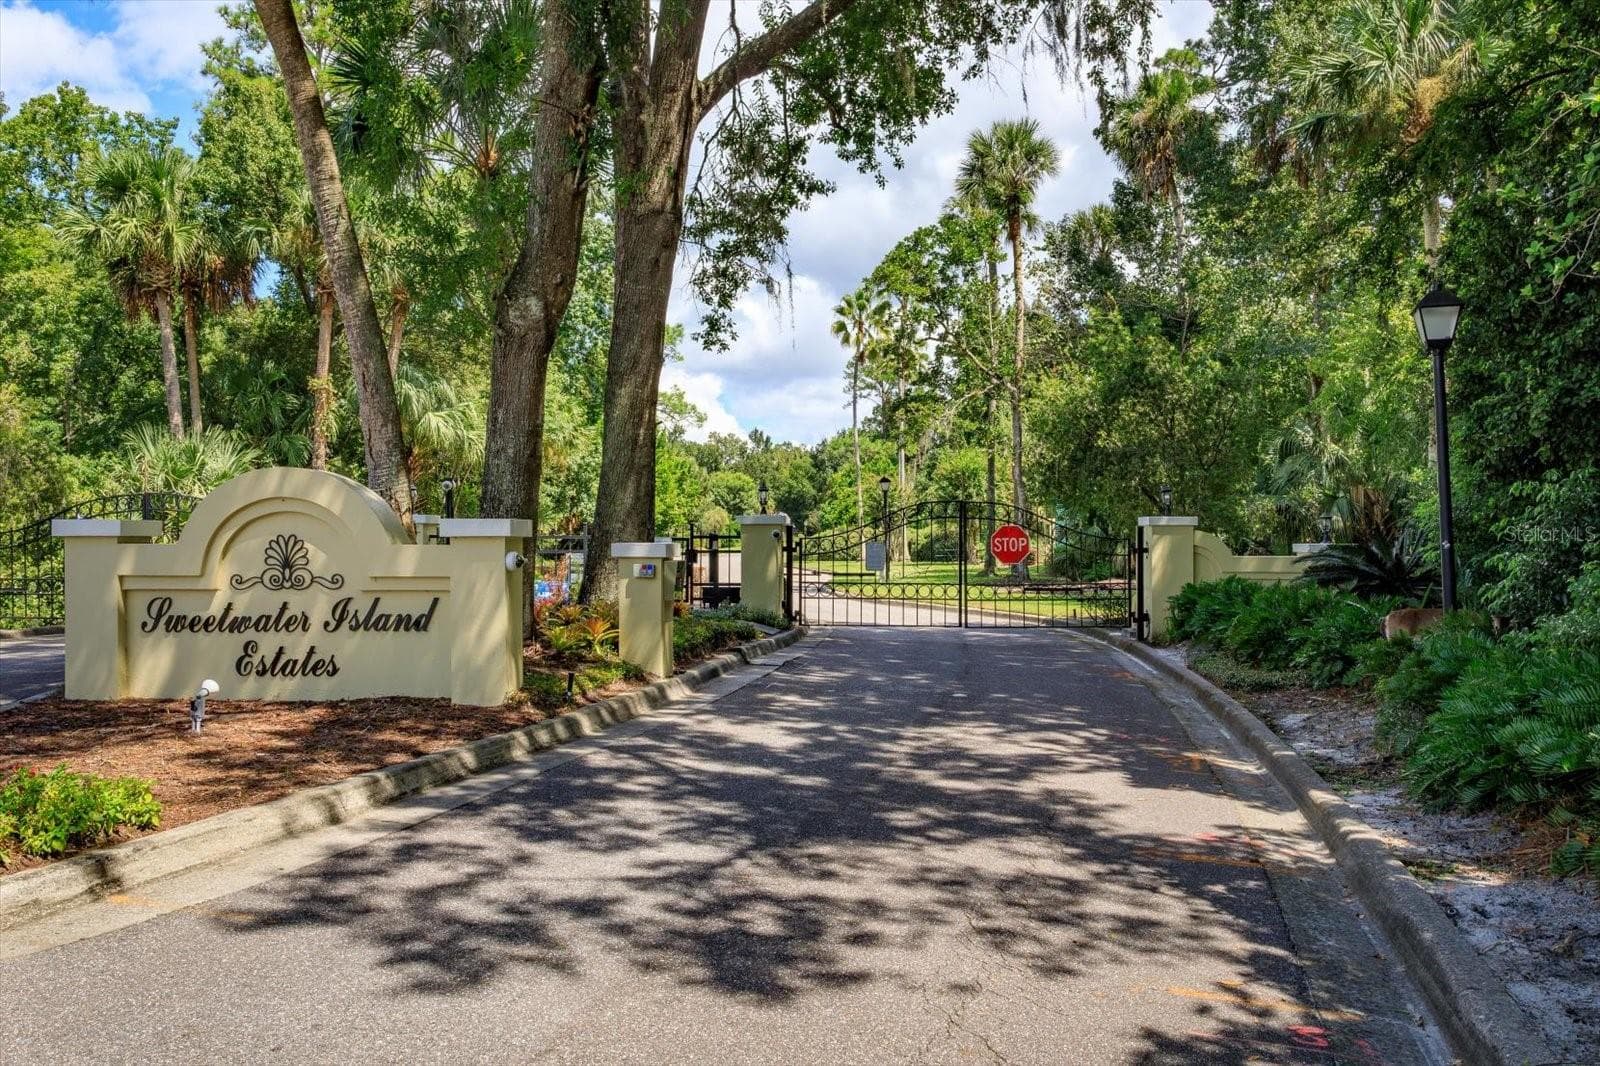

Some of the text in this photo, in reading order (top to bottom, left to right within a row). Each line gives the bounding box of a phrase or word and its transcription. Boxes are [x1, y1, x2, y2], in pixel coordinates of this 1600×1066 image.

[994, 537, 1027, 552] STOP
[141, 597, 439, 633] Sweetwater Island
[235, 640, 340, 677] Estates
